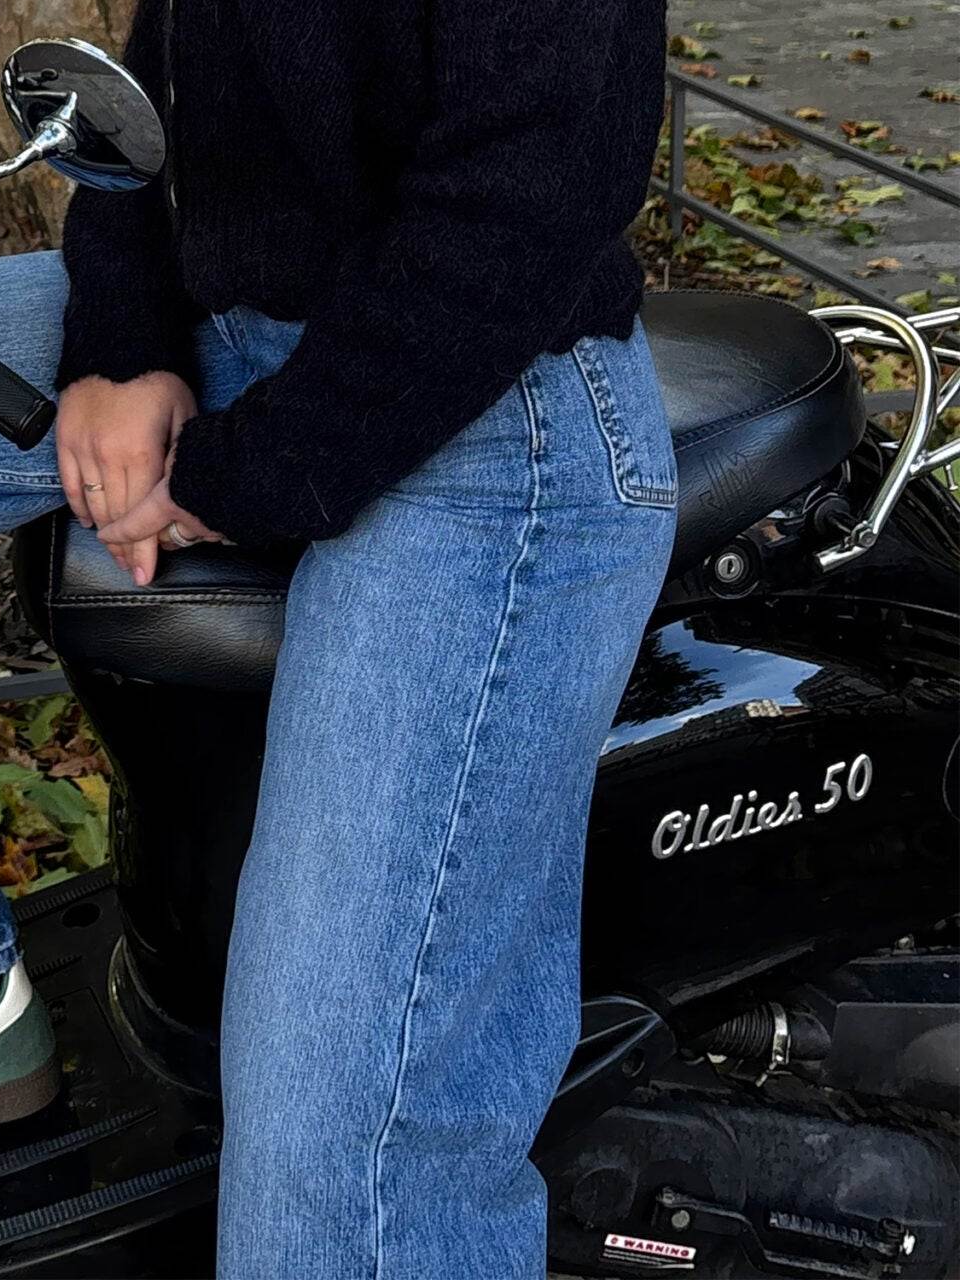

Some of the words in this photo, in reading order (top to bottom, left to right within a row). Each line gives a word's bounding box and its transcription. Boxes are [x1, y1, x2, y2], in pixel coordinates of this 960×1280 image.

[651, 790, 803, 859] Oldies
[814, 753, 873, 813] 50
[623, 1239, 690, 1257] WARNING
